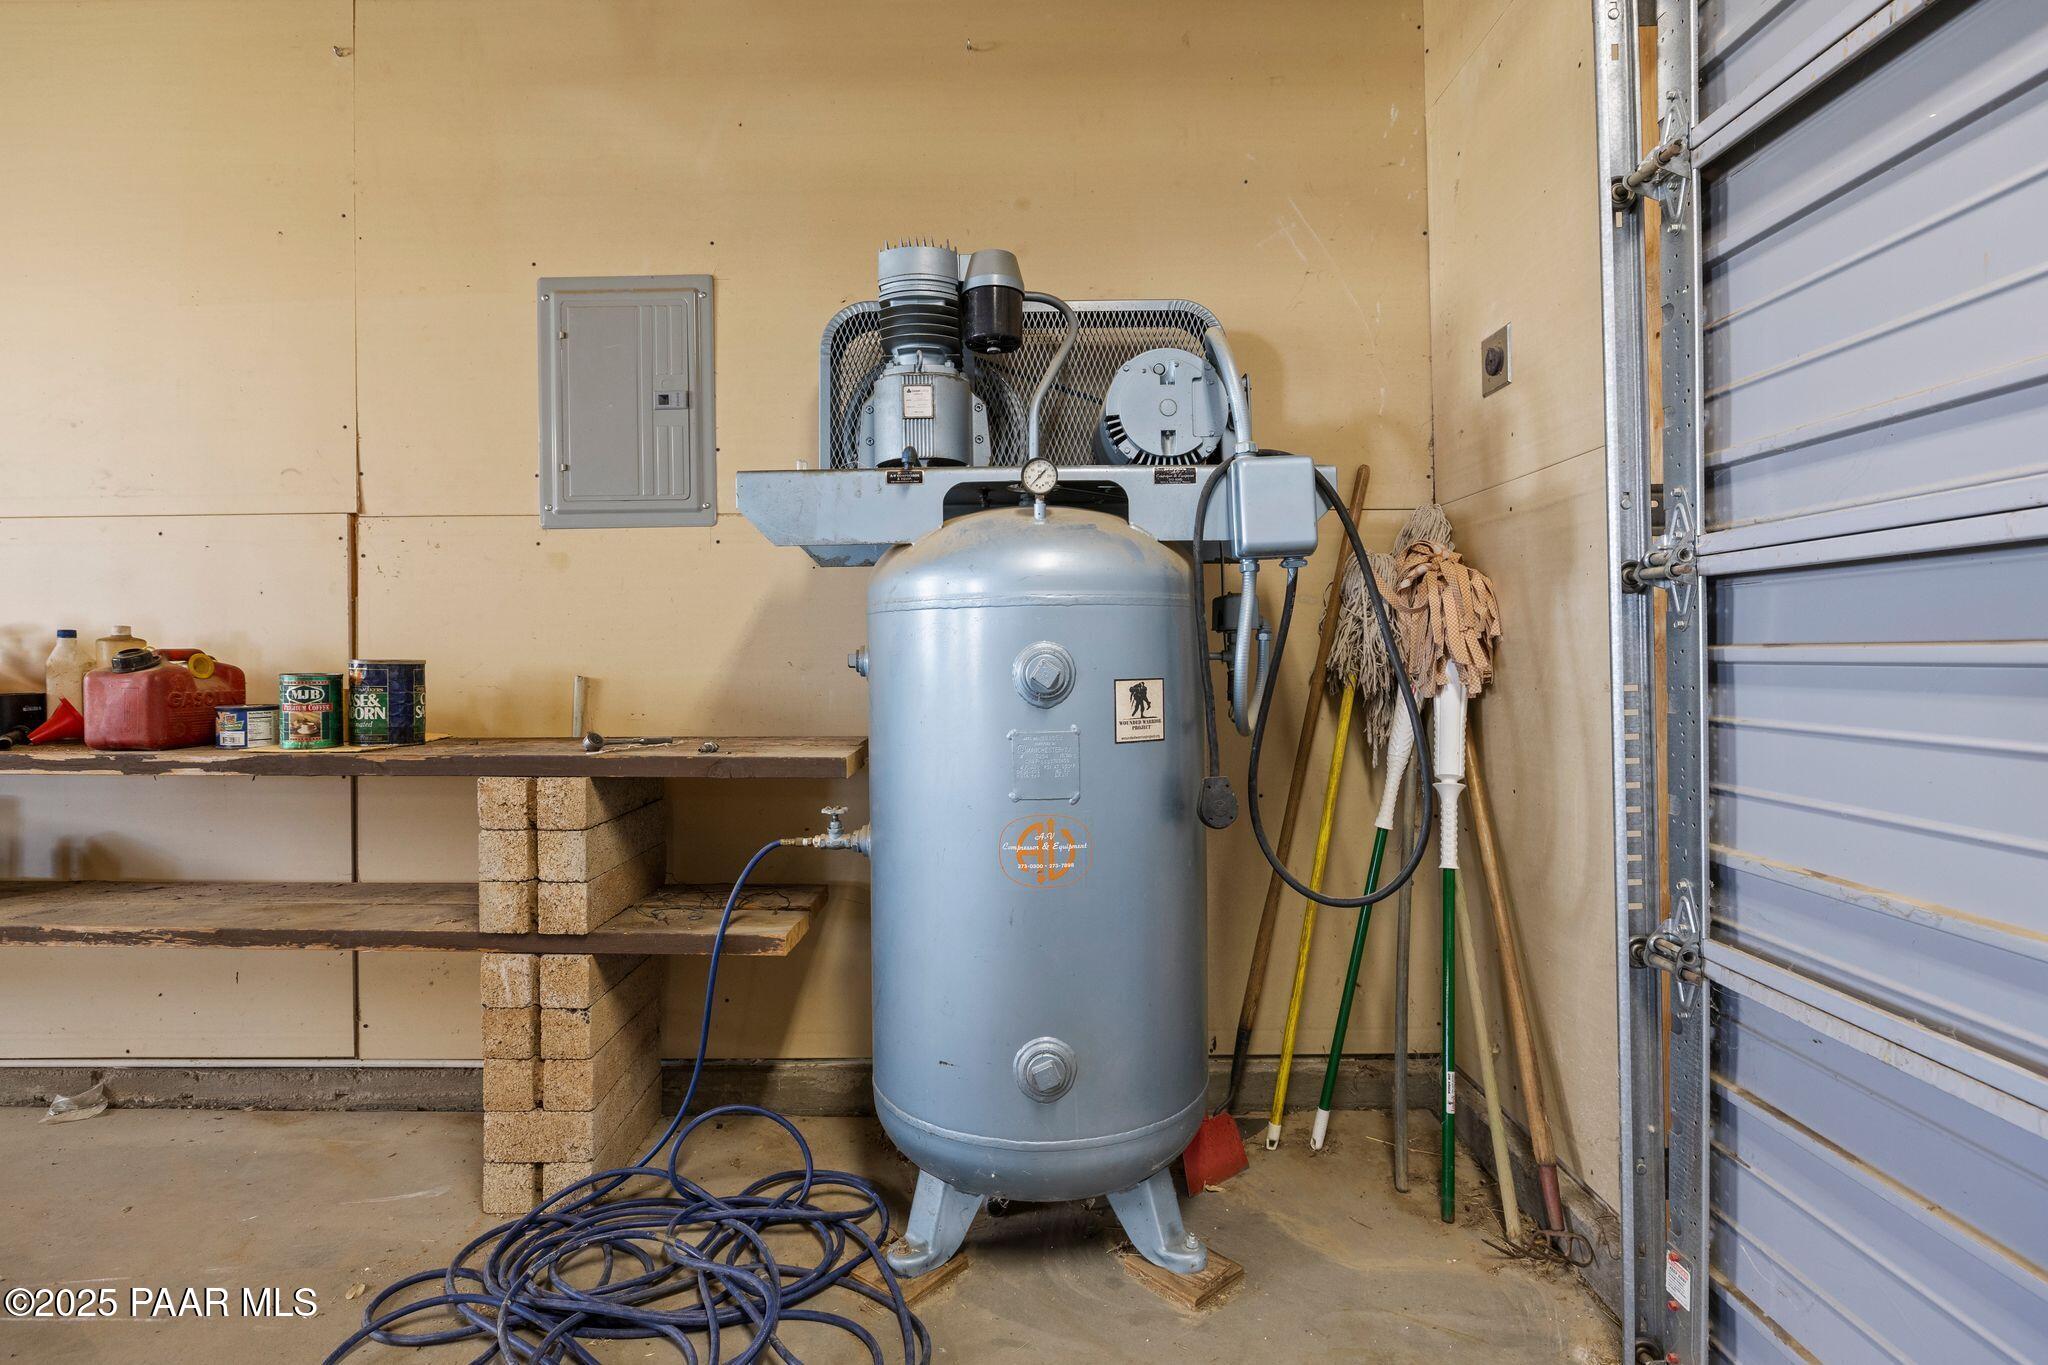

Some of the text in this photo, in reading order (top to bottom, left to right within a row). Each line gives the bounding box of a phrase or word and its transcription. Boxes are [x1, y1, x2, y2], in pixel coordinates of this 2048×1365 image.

[291, 690, 320, 699] MJB
[352, 693, 381, 707] SE&
[1041, 842, 1050, 851] &
[1052, 841, 1088, 852] Equipment
